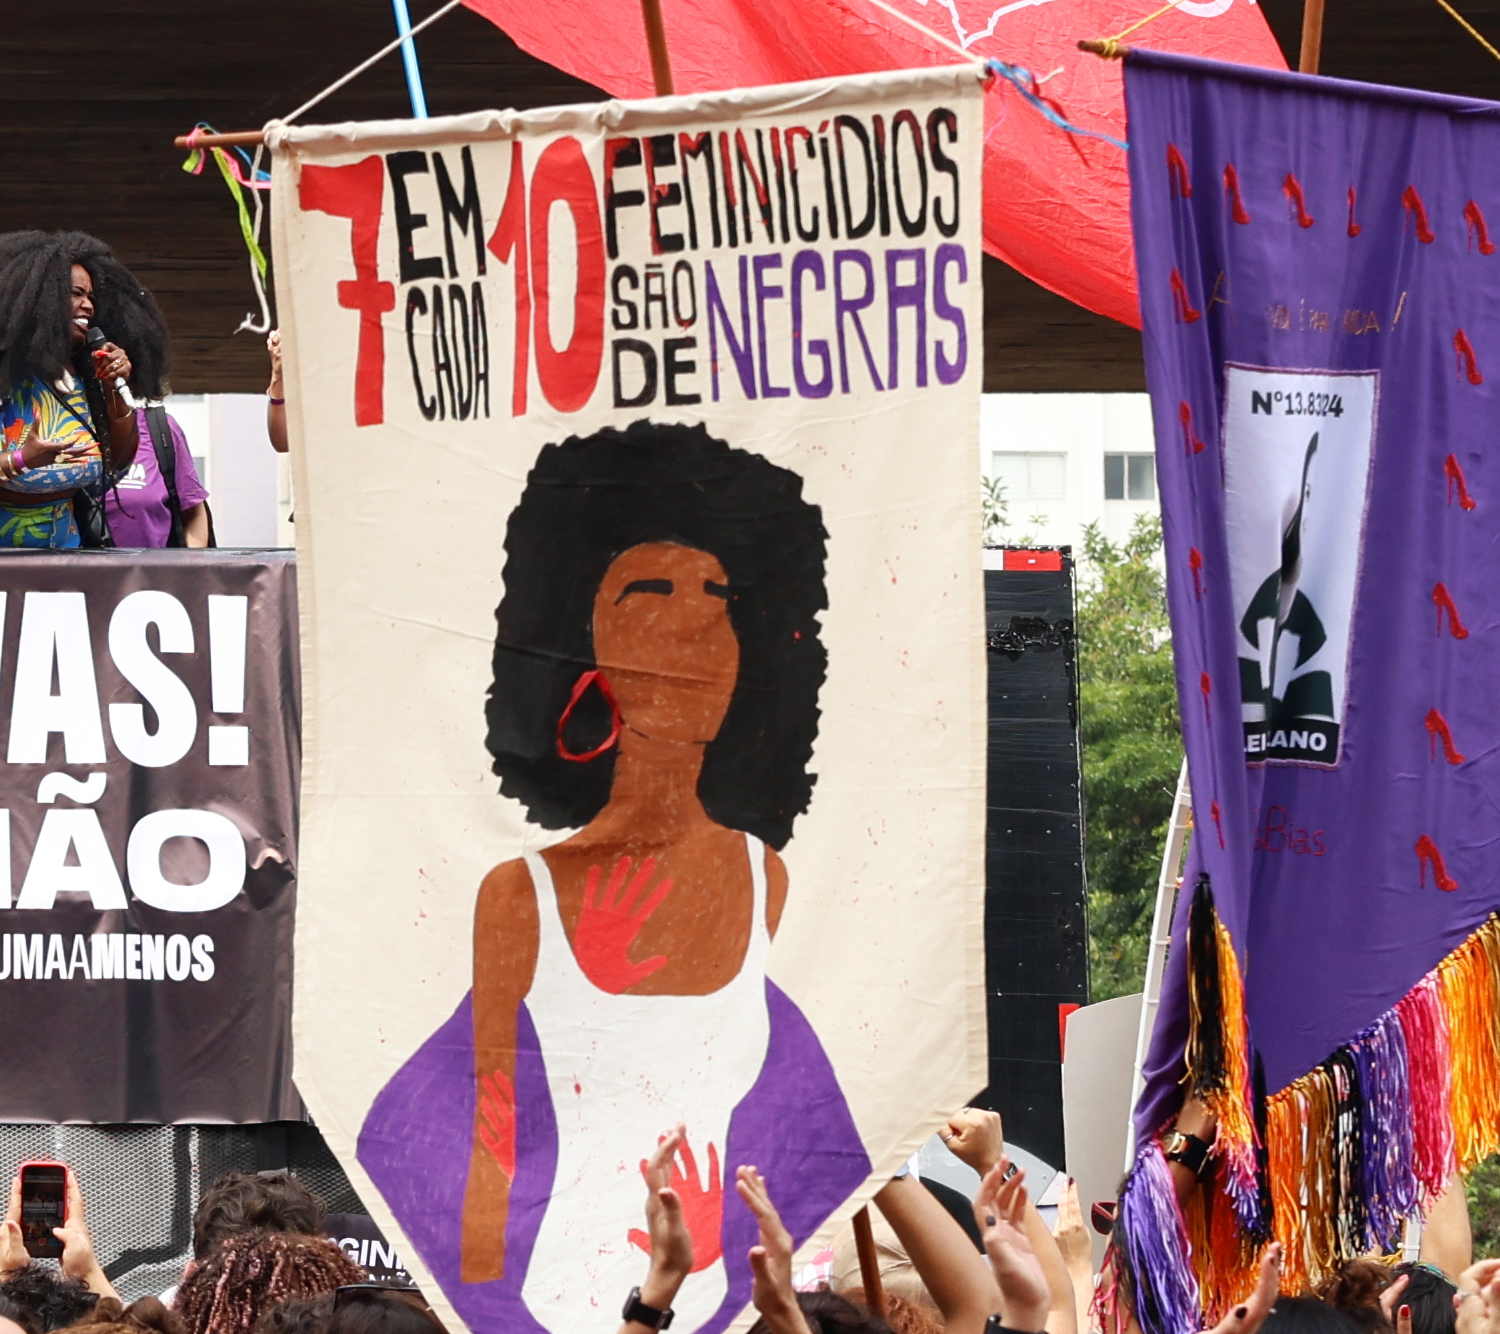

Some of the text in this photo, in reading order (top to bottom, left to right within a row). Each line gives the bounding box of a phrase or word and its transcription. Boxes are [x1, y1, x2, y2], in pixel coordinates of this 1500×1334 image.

[298, 153, 396, 427] 7
[386, 145, 487, 283] EM
[486, 135, 605, 418] 10
[405, 243, 969, 422] CADA SÃO NEGRAS
[612, 337, 702, 409] DE
